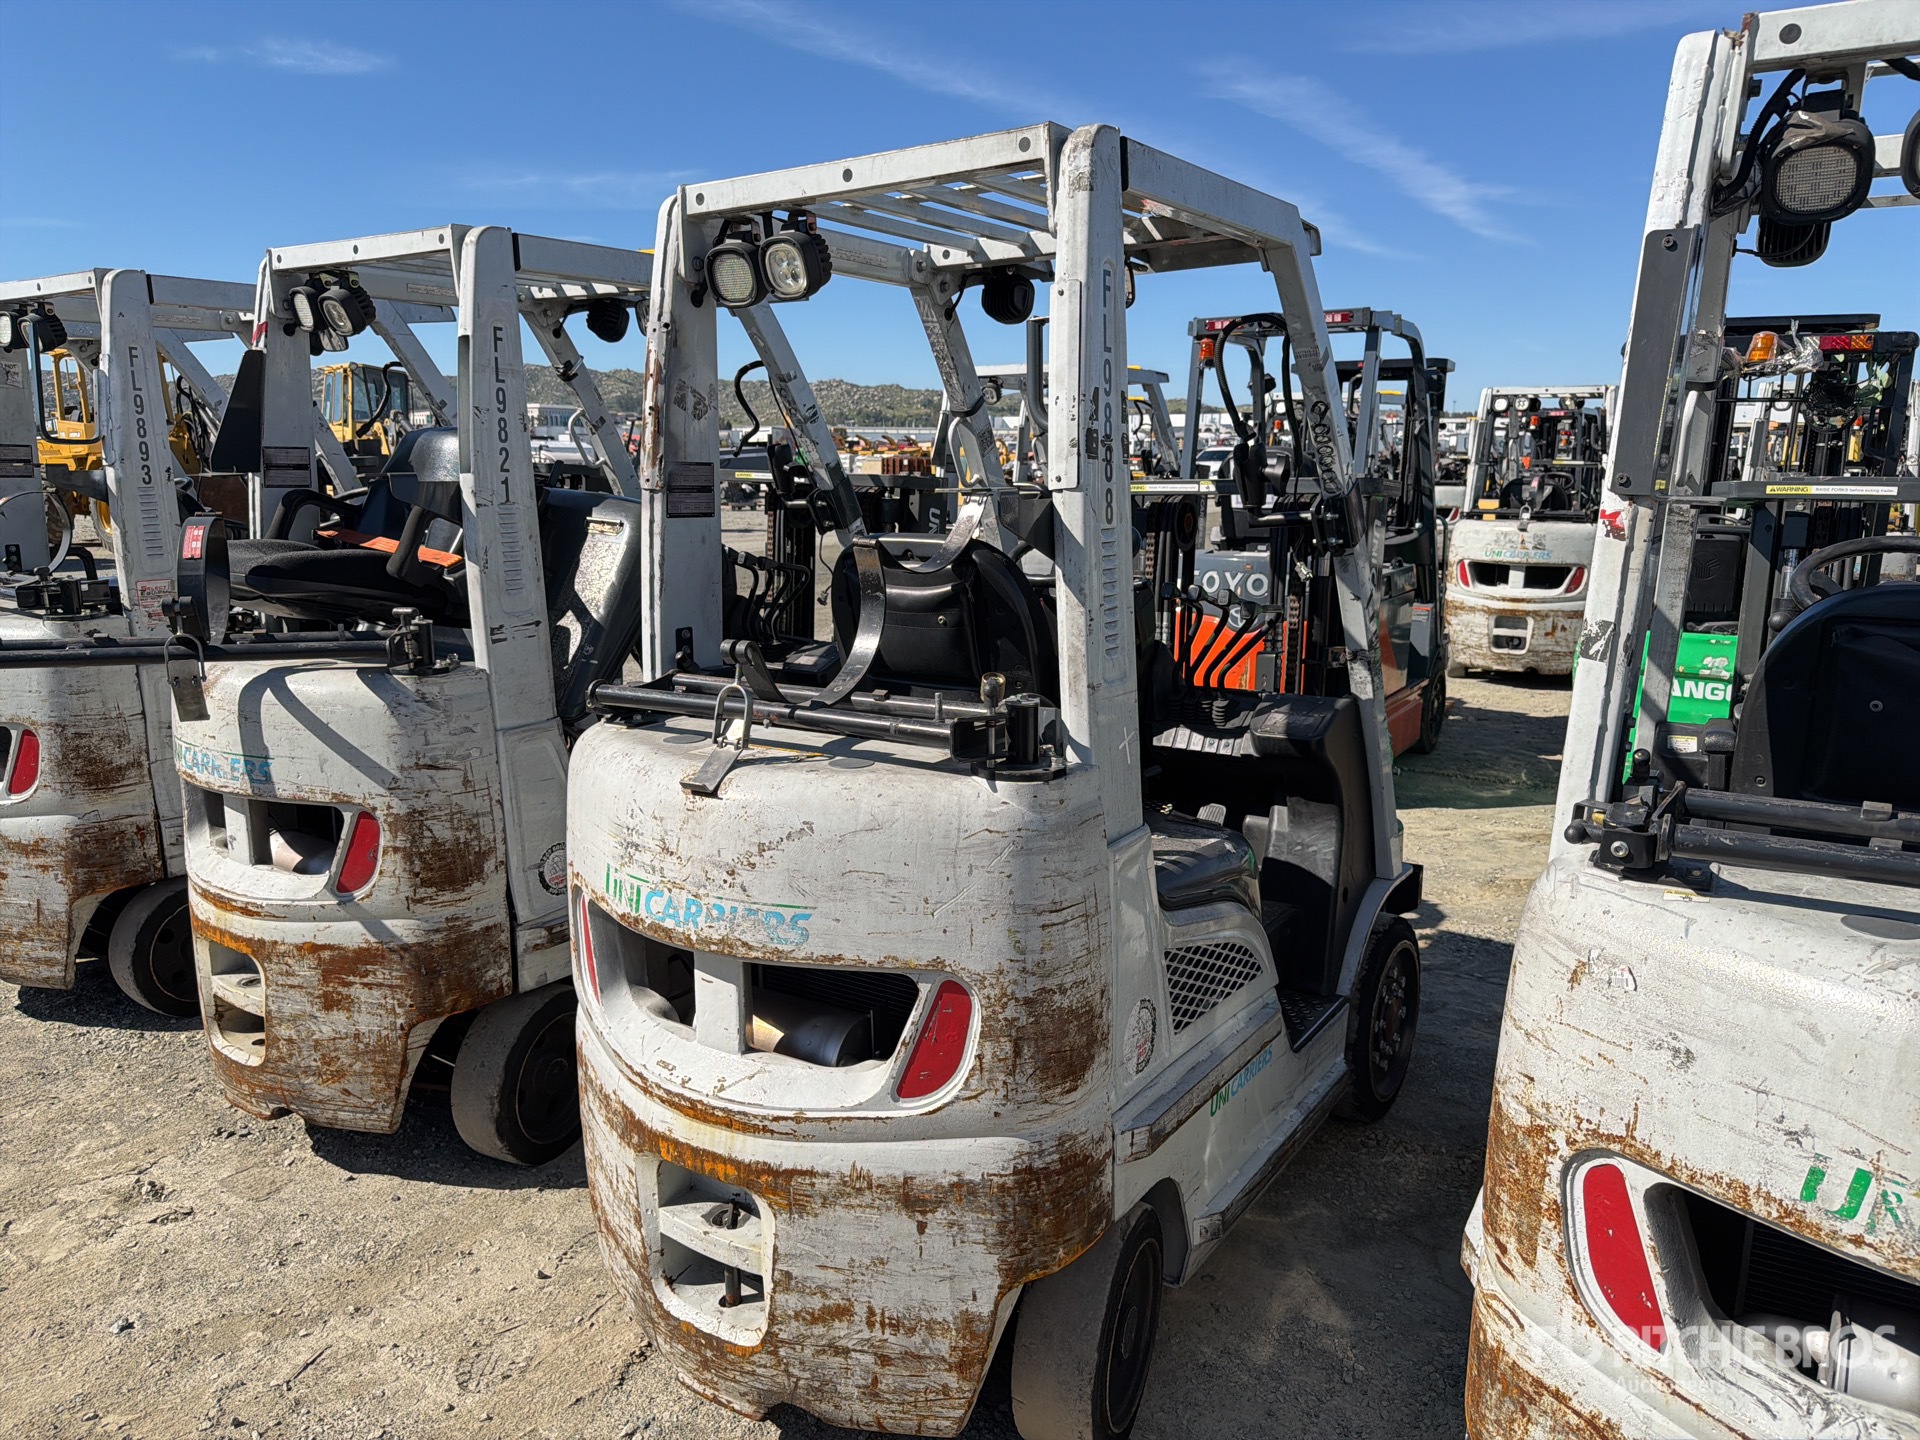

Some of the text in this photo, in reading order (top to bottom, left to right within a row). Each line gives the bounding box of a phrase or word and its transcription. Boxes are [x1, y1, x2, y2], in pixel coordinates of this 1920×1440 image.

[128, 346, 152, 485] FL9893
[493, 326, 511, 504] FL9821
[1103, 269, 1114, 525] FL9888
